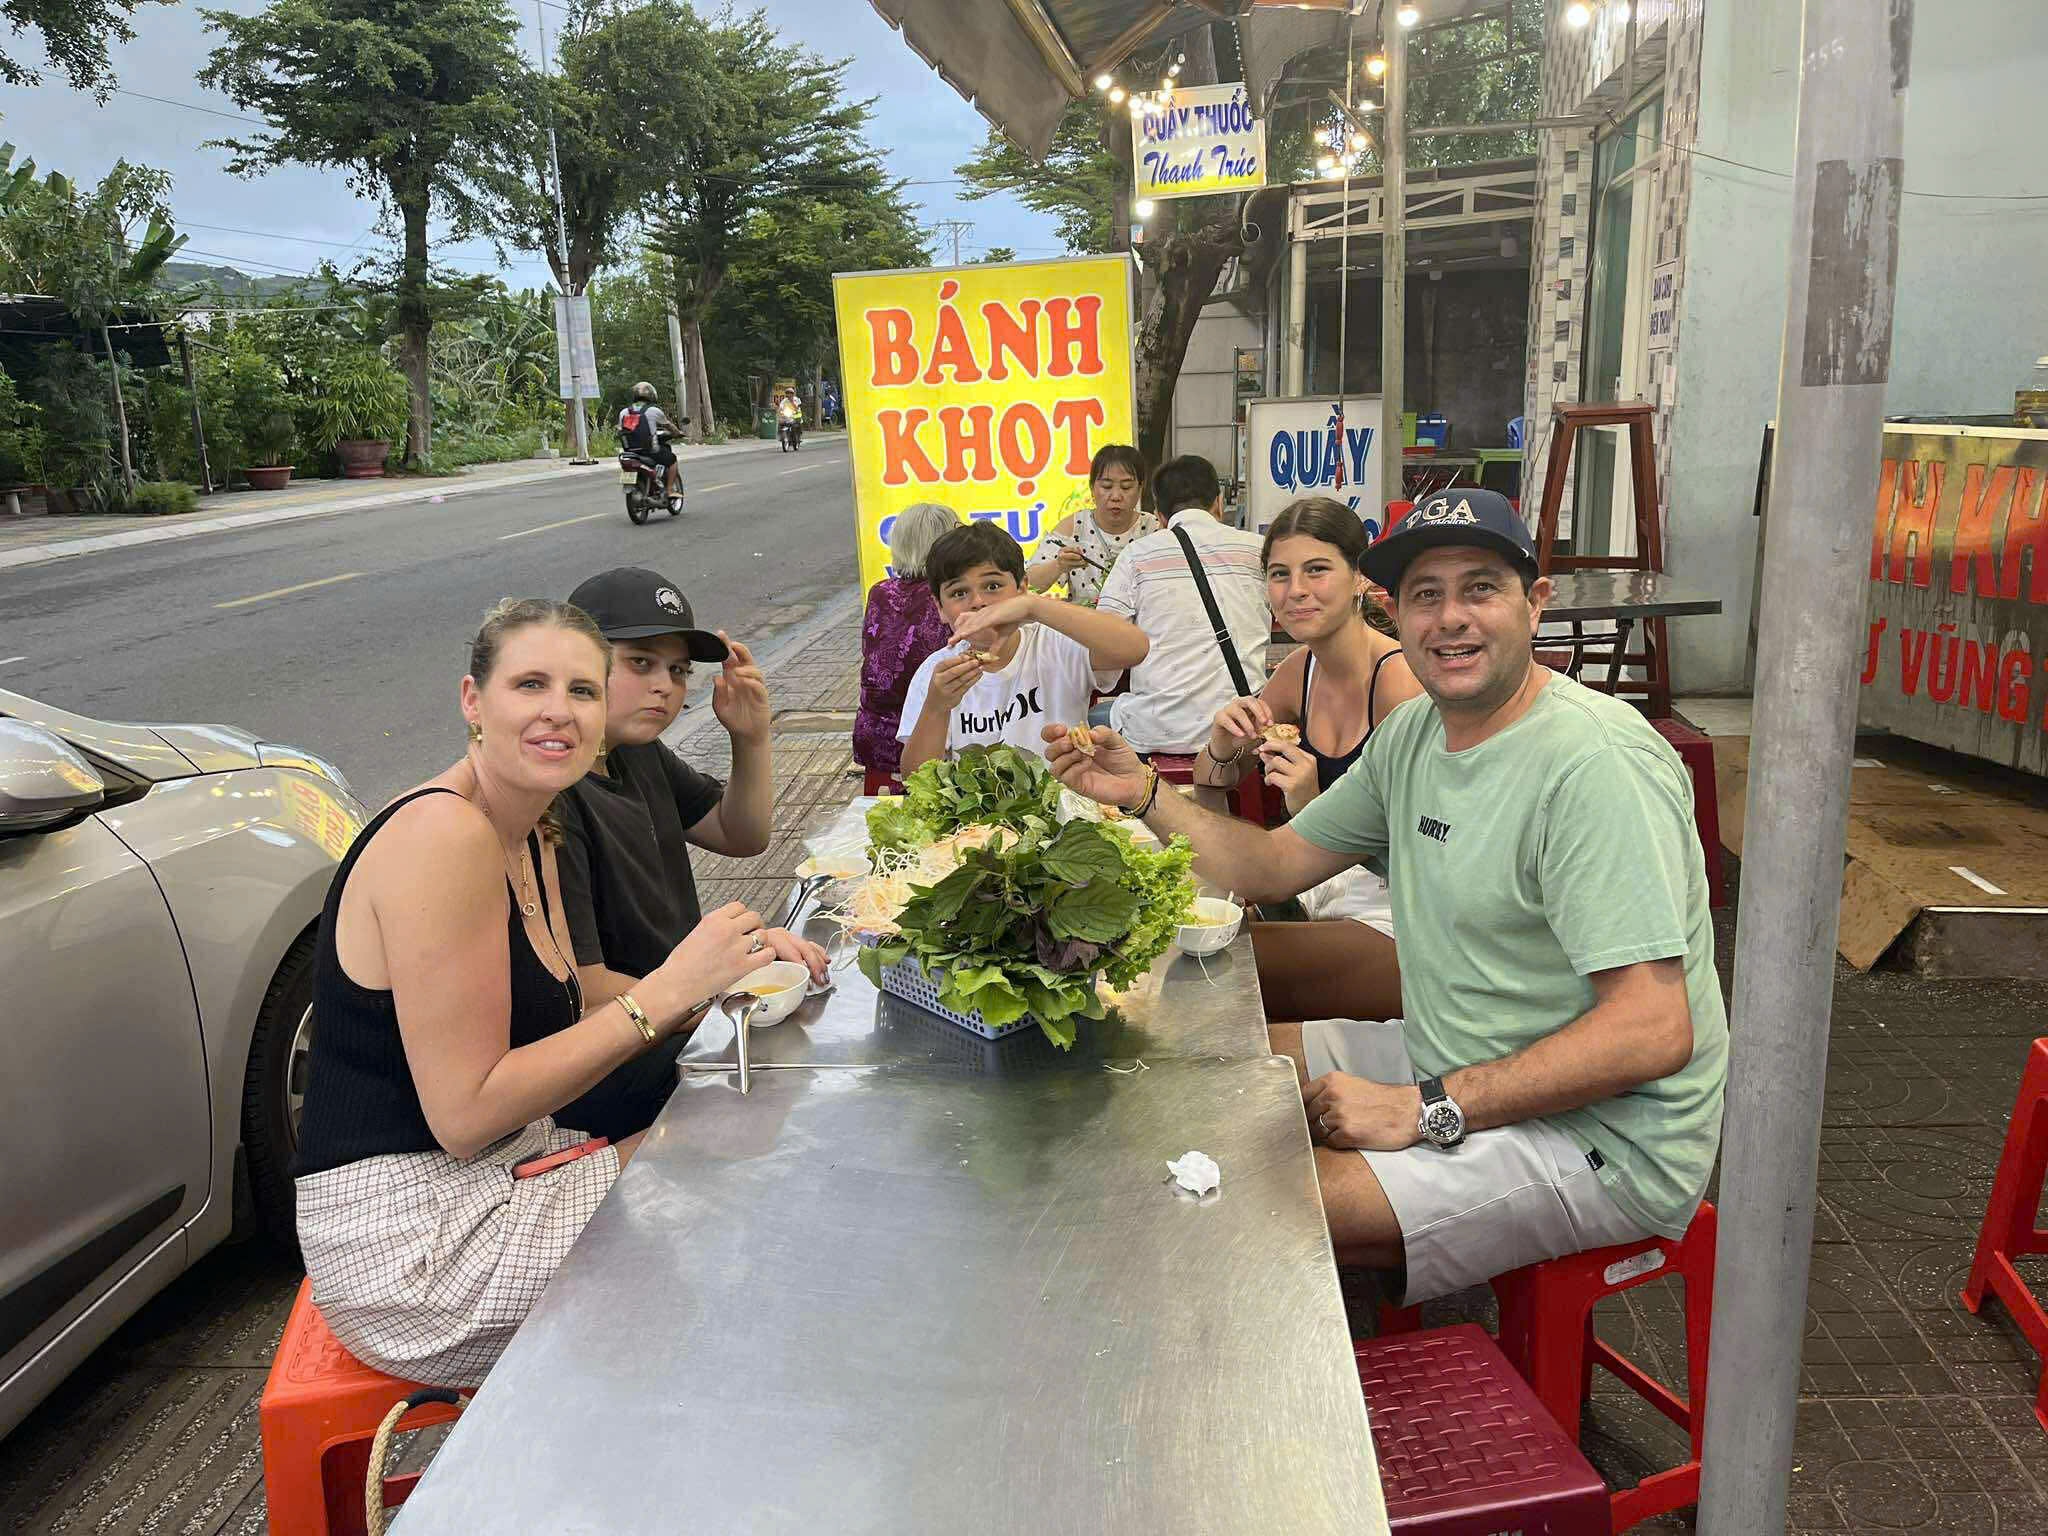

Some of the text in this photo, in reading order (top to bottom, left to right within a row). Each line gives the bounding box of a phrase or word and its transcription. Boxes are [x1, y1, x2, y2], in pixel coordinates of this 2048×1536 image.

[1143, 145, 1257, 187] Thanh Trúc
[866, 281, 1103, 386] BÁNH
[878, 399, 1104, 496] KHỌT
[1270, 404, 1374, 494] QUẦY
